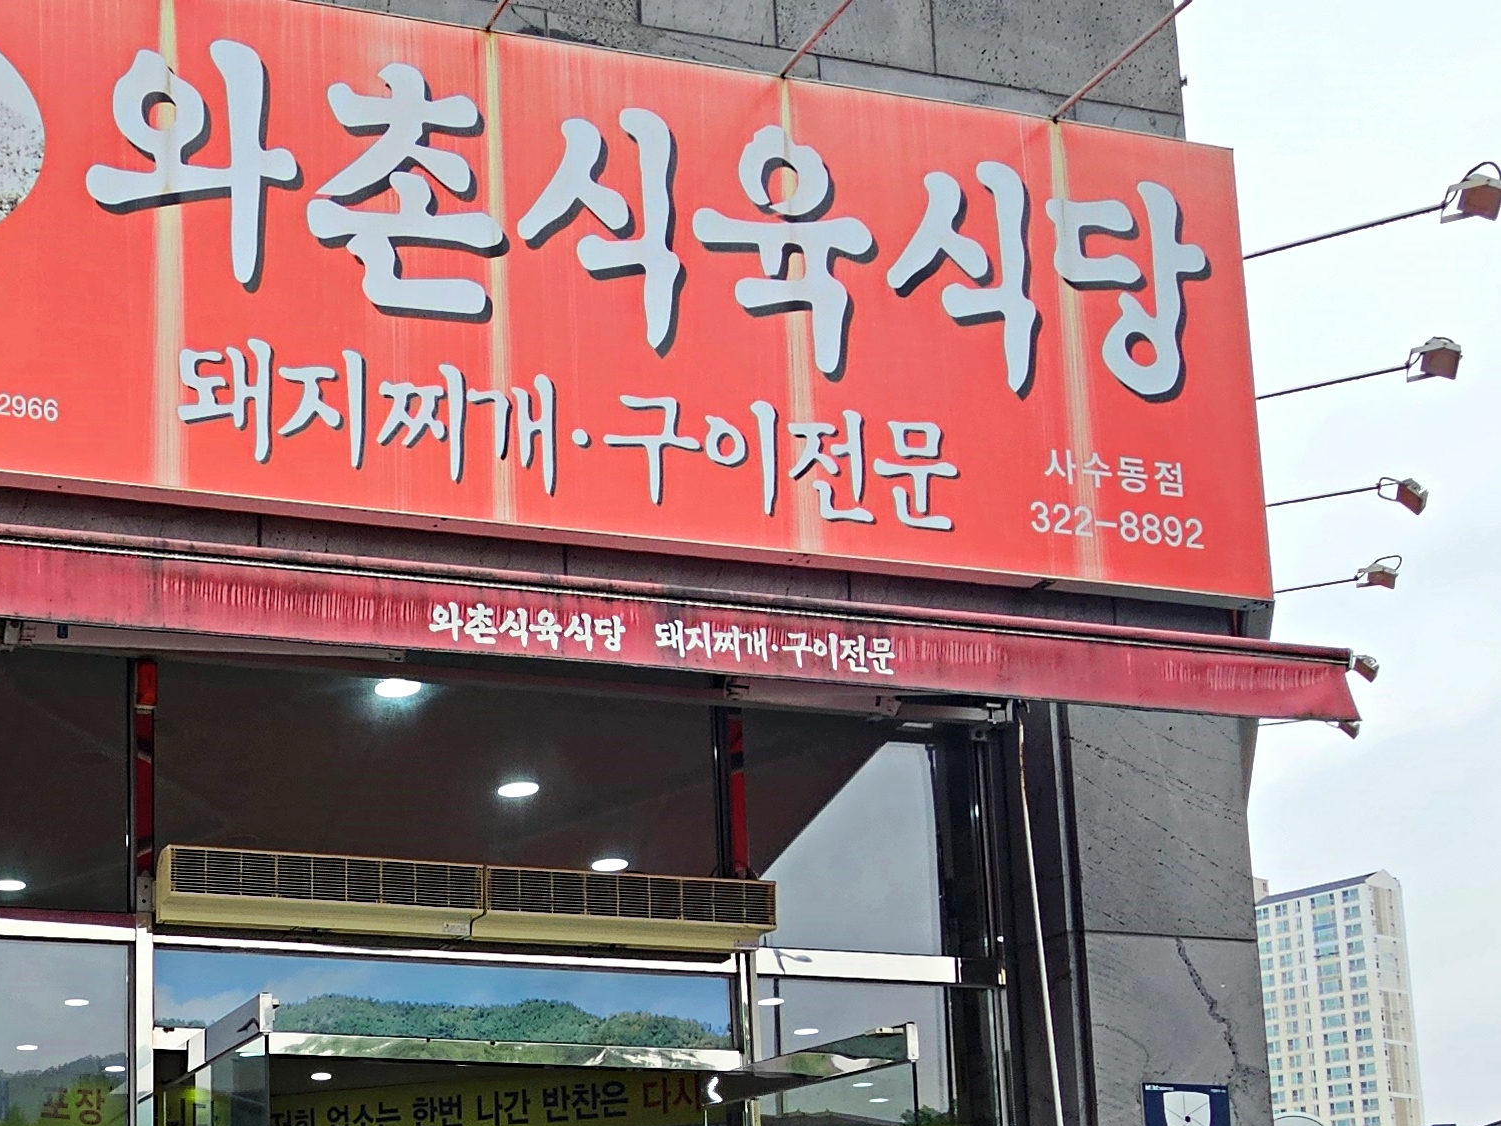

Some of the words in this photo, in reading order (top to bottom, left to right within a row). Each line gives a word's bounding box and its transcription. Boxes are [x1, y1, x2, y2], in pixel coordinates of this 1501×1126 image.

[86, 39, 1212, 402] 와촌식육식당
[1043, 448, 1185, 499] 사수동점
[1029, 501, 1205, 551] 322-8892
[428, 601, 626, 653] 와촌식육식당
[476, 1089, 531, 1126] 나간
[541, 1080, 628, 1122] 반찬은
